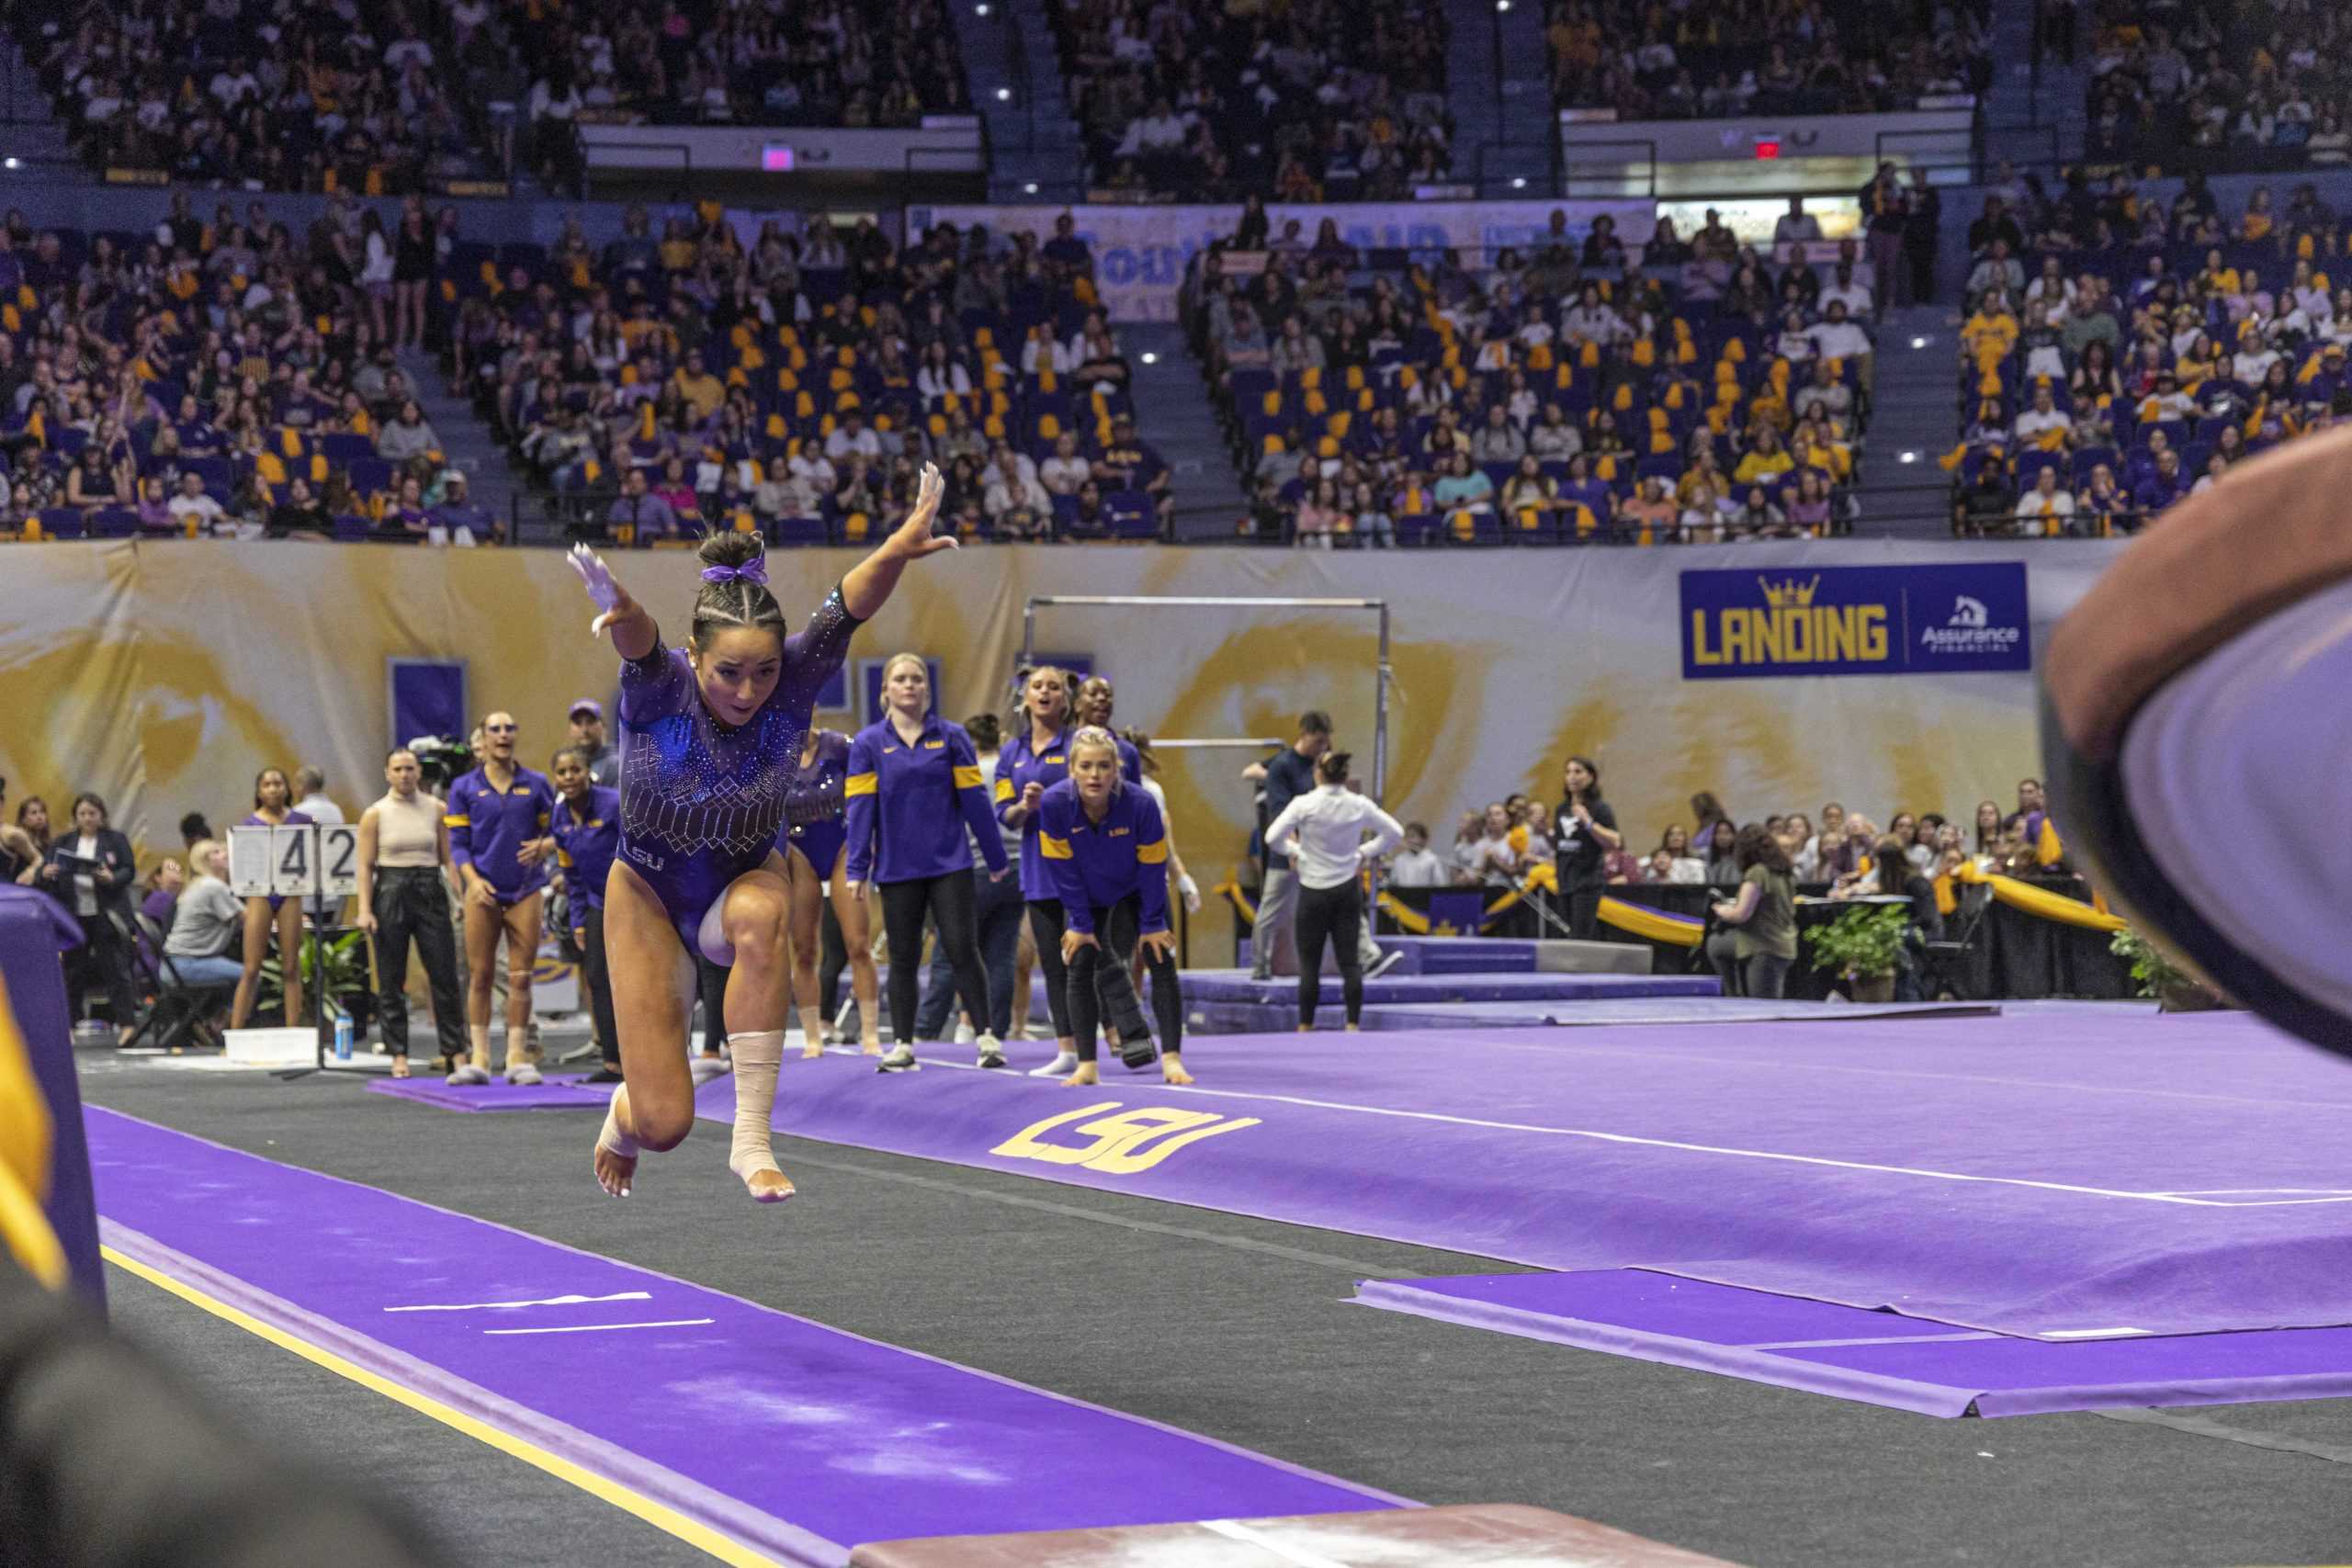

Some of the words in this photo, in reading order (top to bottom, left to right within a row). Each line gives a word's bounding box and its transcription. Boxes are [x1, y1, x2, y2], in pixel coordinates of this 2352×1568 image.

[1692, 605, 1888, 665] LANDING
[1921, 626, 2019, 645] Assurance
[280, 829, 307, 878] 4
[327, 829, 356, 878] 2
[989, 1101, 1262, 1174] LSU
